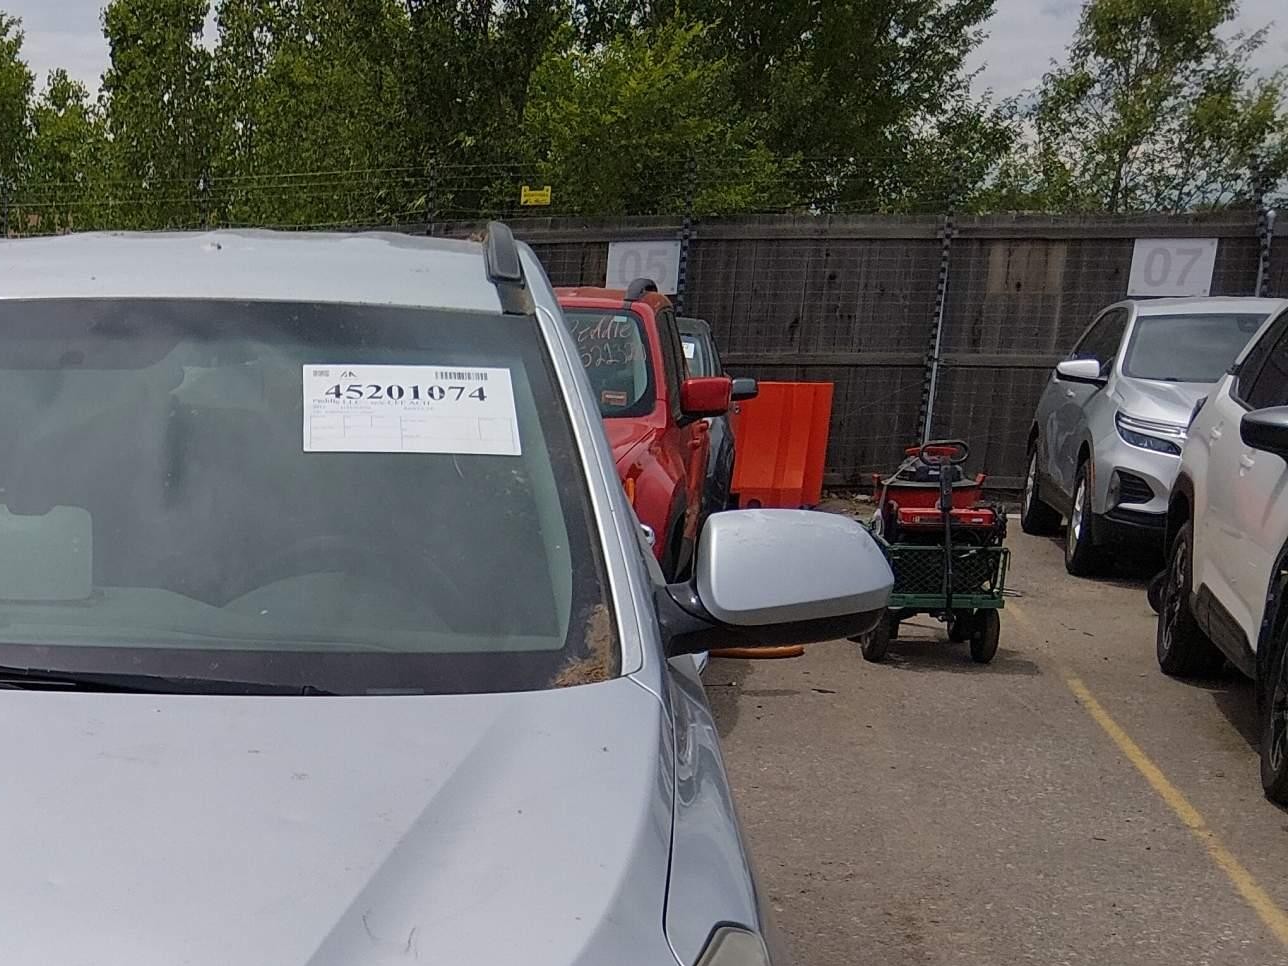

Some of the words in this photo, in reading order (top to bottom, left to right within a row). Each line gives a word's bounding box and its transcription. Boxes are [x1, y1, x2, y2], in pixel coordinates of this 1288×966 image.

[619, 250, 668, 286] 05
[1143, 247, 1203, 287] 07
[324, 383, 489, 401] 45201074
